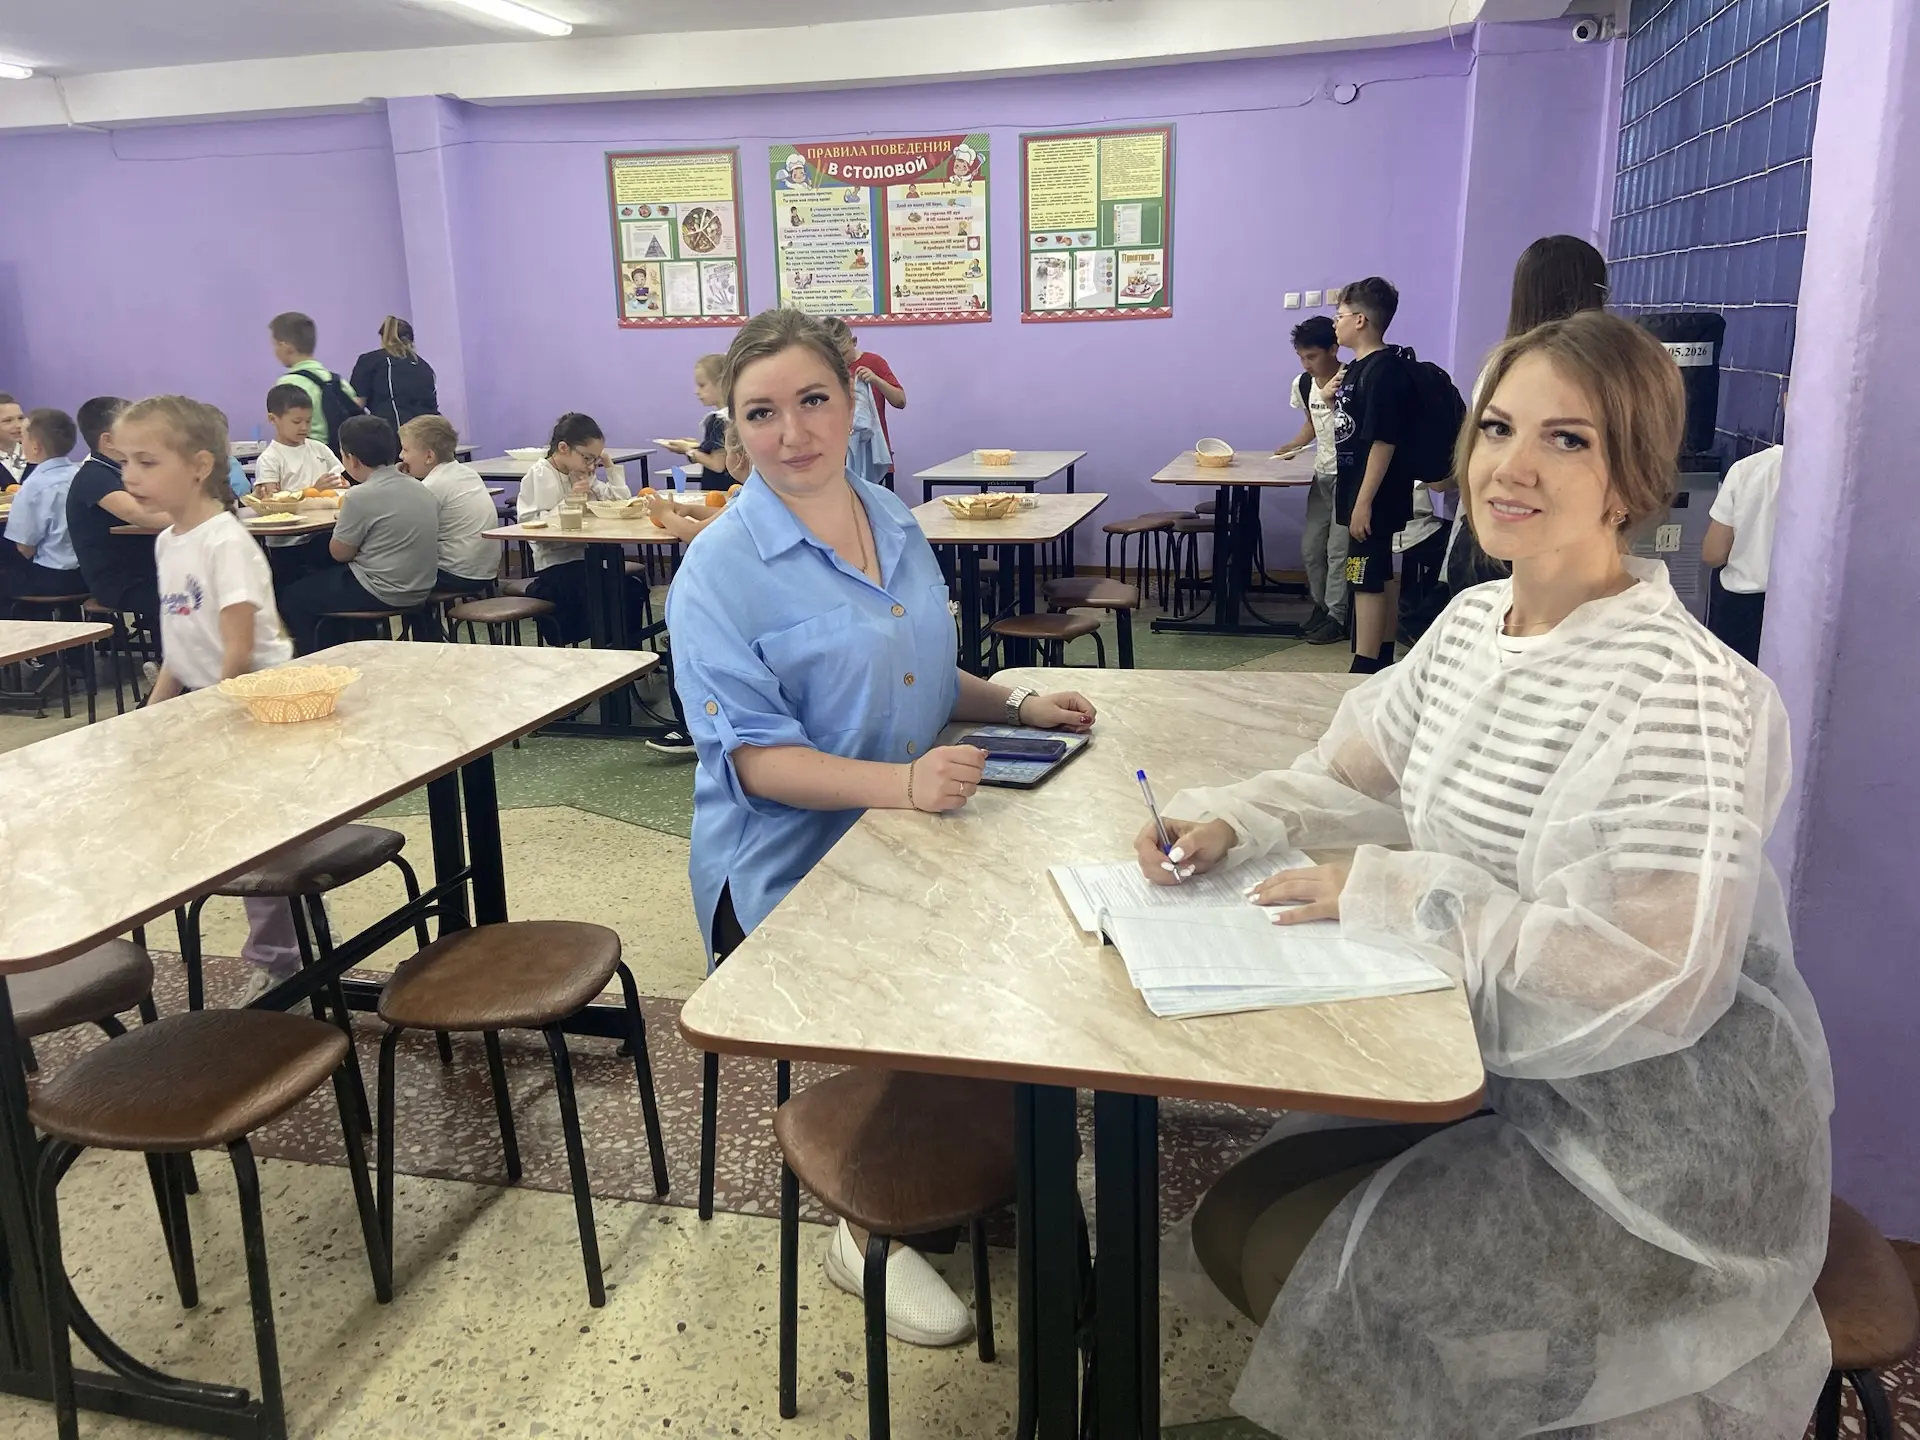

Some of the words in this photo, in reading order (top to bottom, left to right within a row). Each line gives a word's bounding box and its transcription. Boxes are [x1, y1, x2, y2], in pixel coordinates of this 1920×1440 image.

[808, 144, 867, 159] ПРАВИЛА
[871, 140, 952, 156] ПОВЕДЕНИЯ
[828, 162, 838, 176] В
[843, 155, 928, 180] СТОЛОВОЙ
